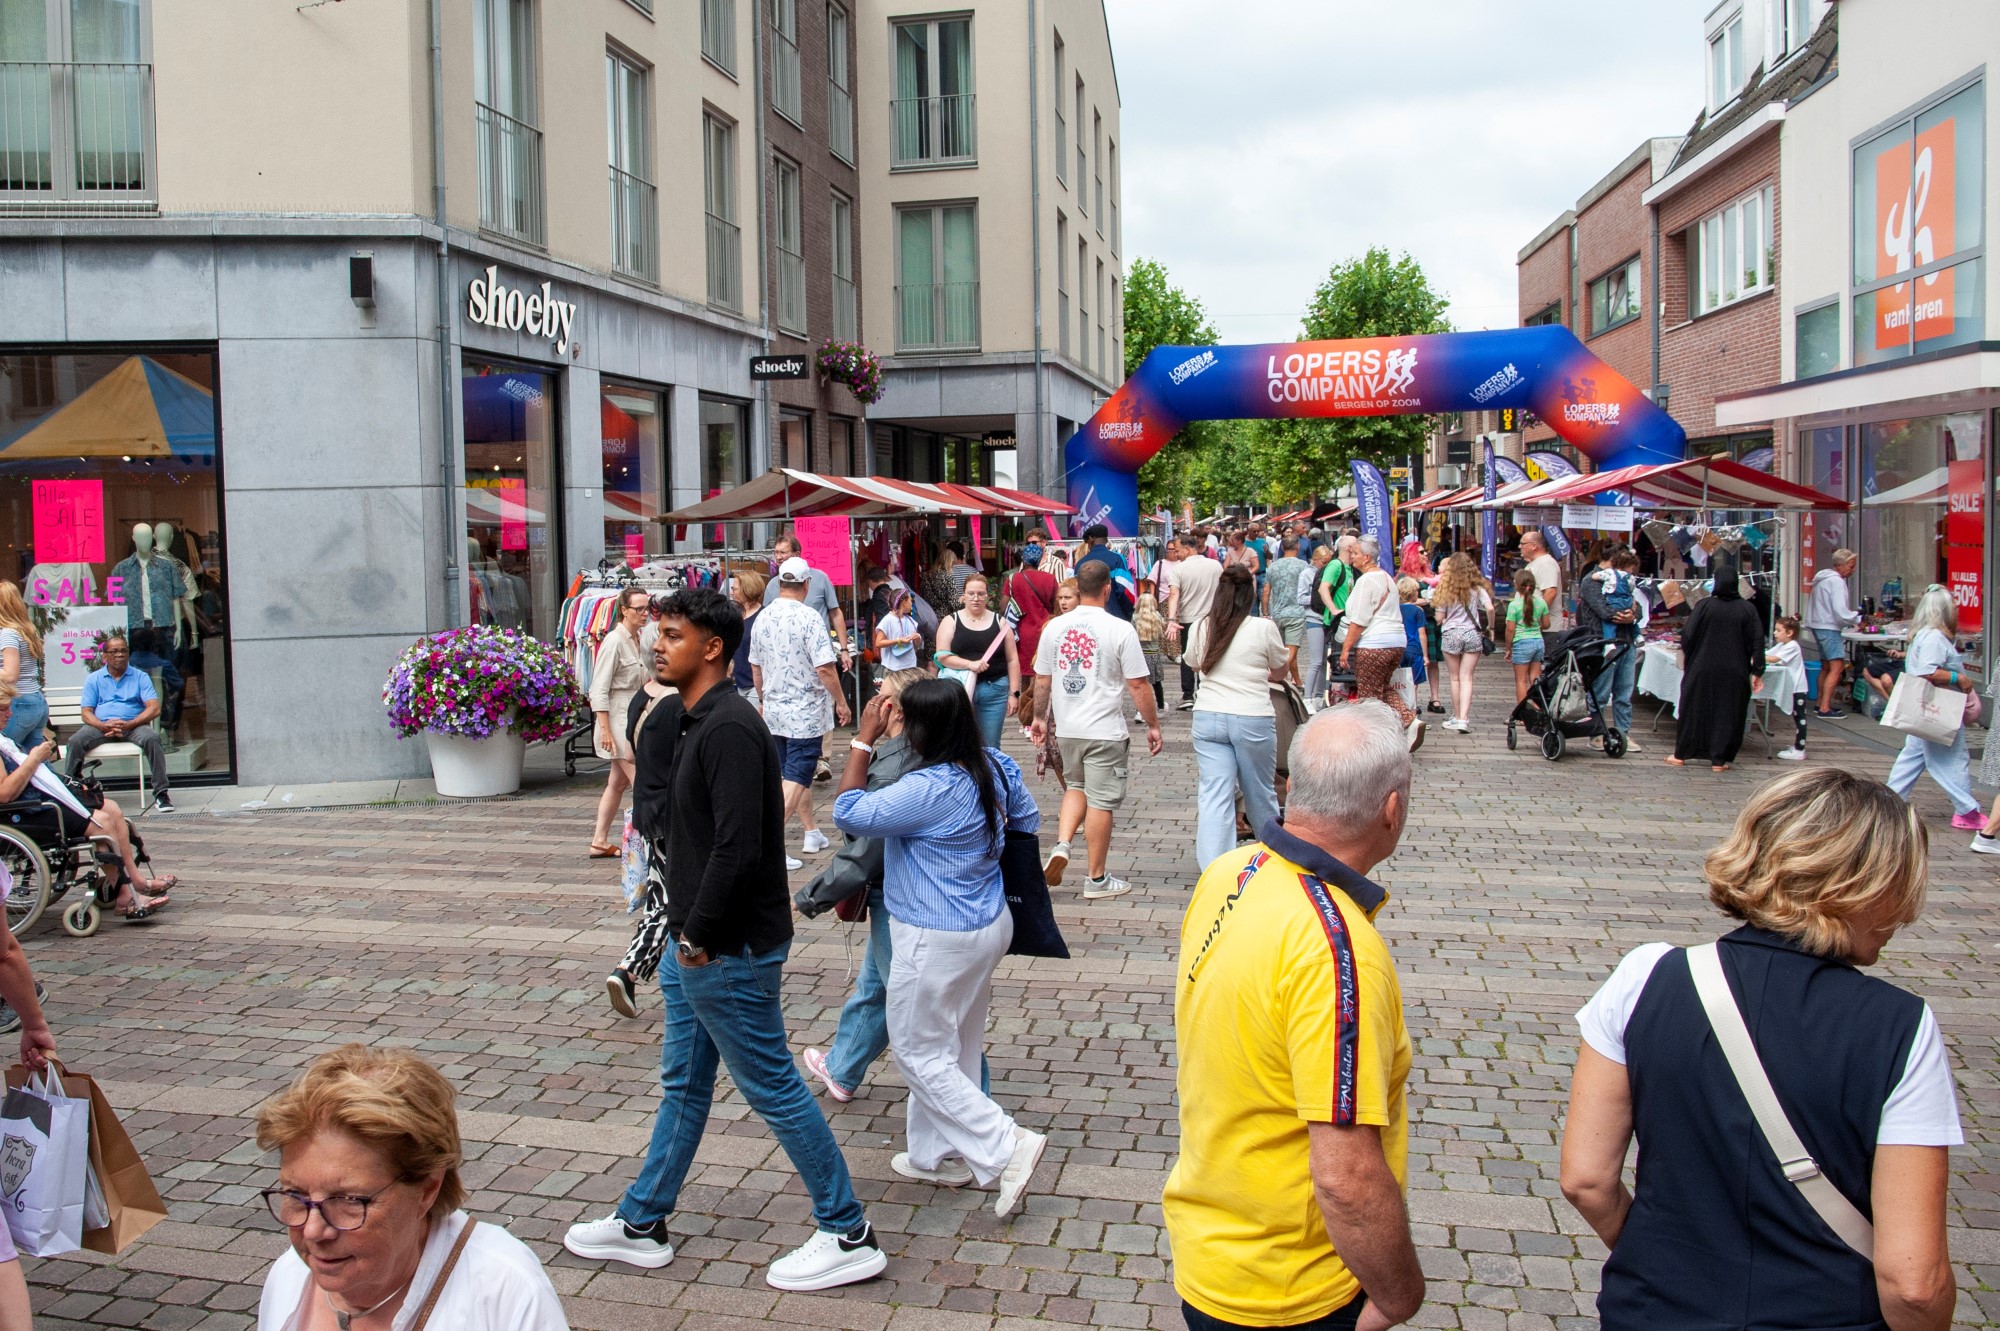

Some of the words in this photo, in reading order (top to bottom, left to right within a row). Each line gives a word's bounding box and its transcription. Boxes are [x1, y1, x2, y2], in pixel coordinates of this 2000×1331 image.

[469, 265, 577, 355] shoeby
[754, 360, 804, 376] shoeby
[1168, 354, 1203, 380] LOPERS
[1173, 360, 1206, 385] COMPANY
[1268, 350, 1381, 379] LOPERS
[1267, 374, 1381, 403] COMPANY
[1469, 371, 1506, 399] LOPERS
[1476, 377, 1511, 403] COMPANY
[1334, 400, 1374, 410] BERGEN
[1376, 399, 1390, 409] OP
[1392, 398, 1421, 407] ZOOM
[1564, 403, 1607, 414] LOPERS
[1564, 411, 1608, 422] COMPANY
[1099, 431, 1134, 440] COMPANY
[1100, 422, 1132, 432] LOPERS
[38, 485, 67, 504] Alle
[1951, 493, 1980, 513] SALE
[1362, 485, 1377, 527] COMPANY
[42, 508, 97, 529] SALE
[797, 520, 817, 533] Alle
[807, 538, 839, 549] binnen
[1951, 572, 1960, 581] NU
[1960, 572, 1978, 583] ALLES
[33, 577, 125, 605] SALE
[80, 630, 102, 638] SALE
[1341, 949, 1354, 1004] Nebulus
[1341, 1044, 1353, 1100] Nebulus
